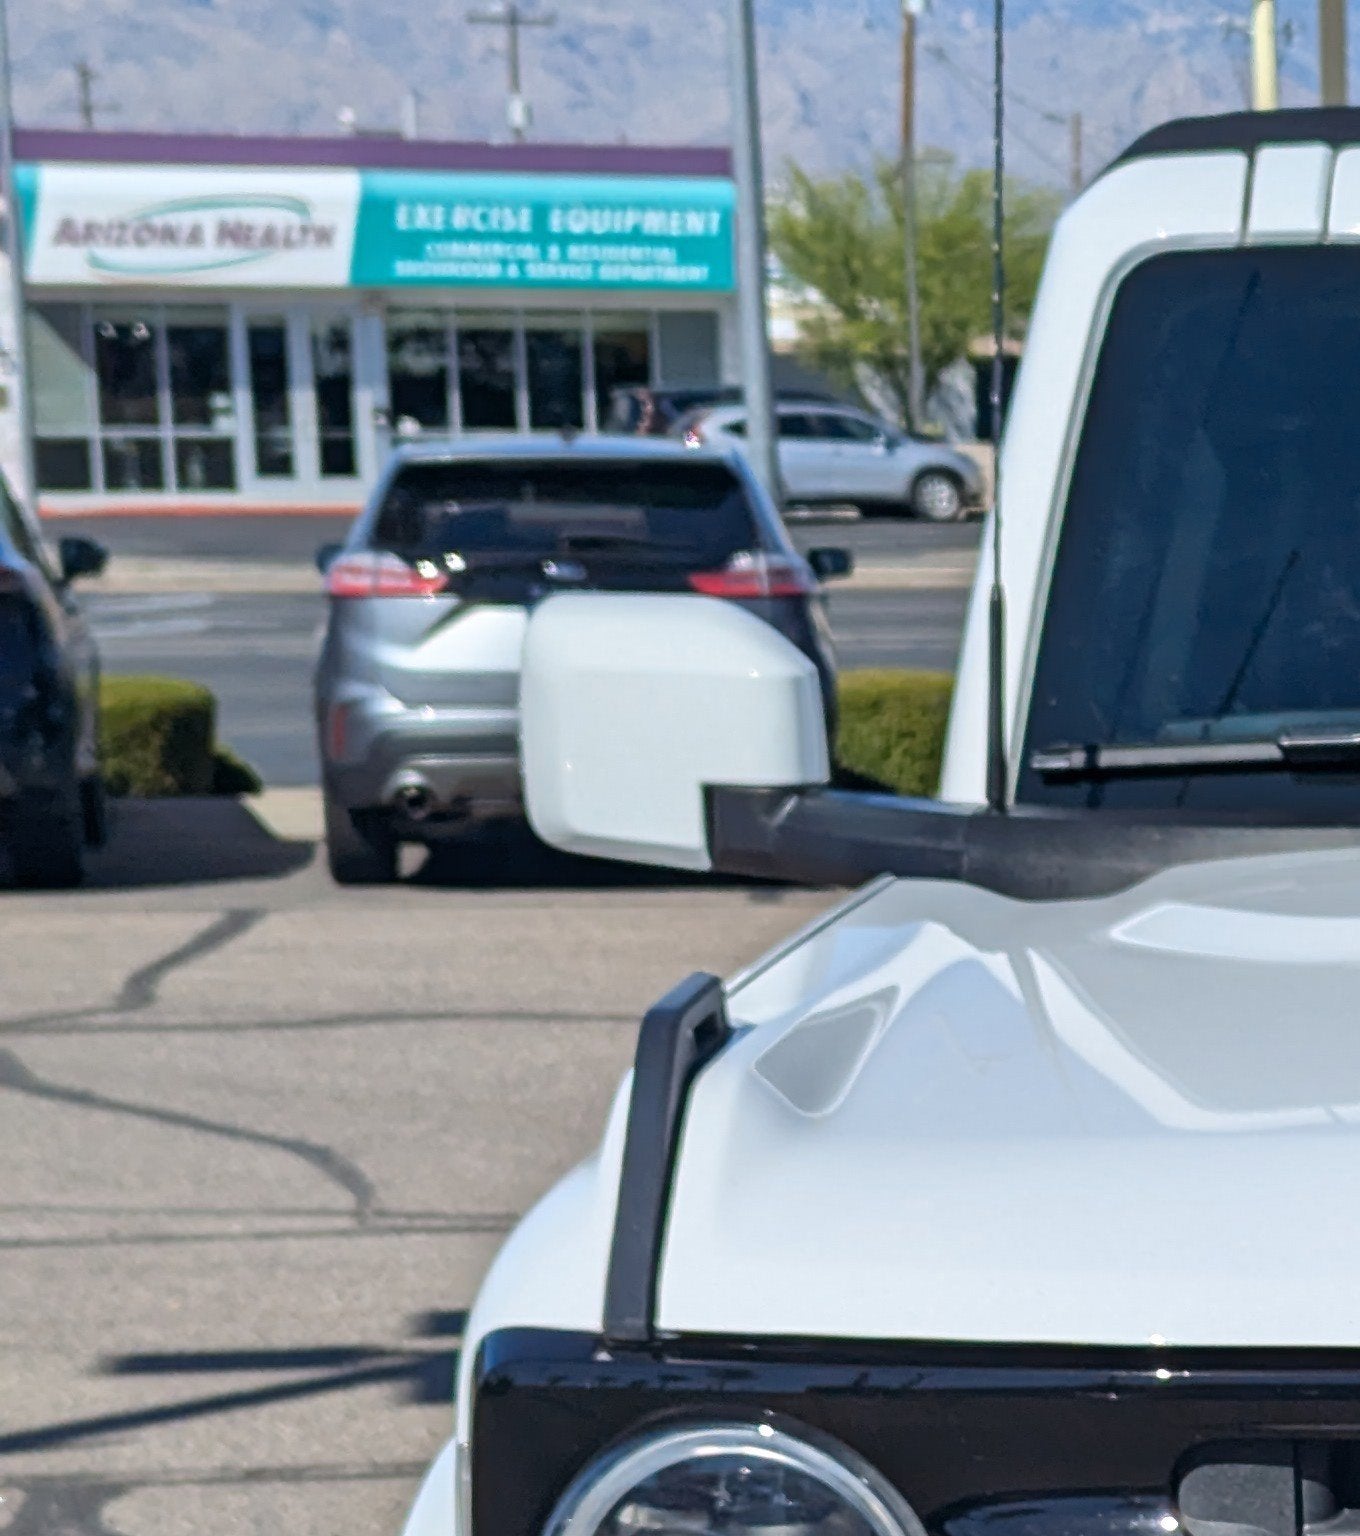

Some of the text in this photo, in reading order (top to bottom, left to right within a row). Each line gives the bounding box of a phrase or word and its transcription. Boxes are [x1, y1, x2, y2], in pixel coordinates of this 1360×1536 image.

[53, 217, 336, 249] ARIZONA HEALTH
[396, 204, 721, 236] EXERCISE EQUIPMENT
